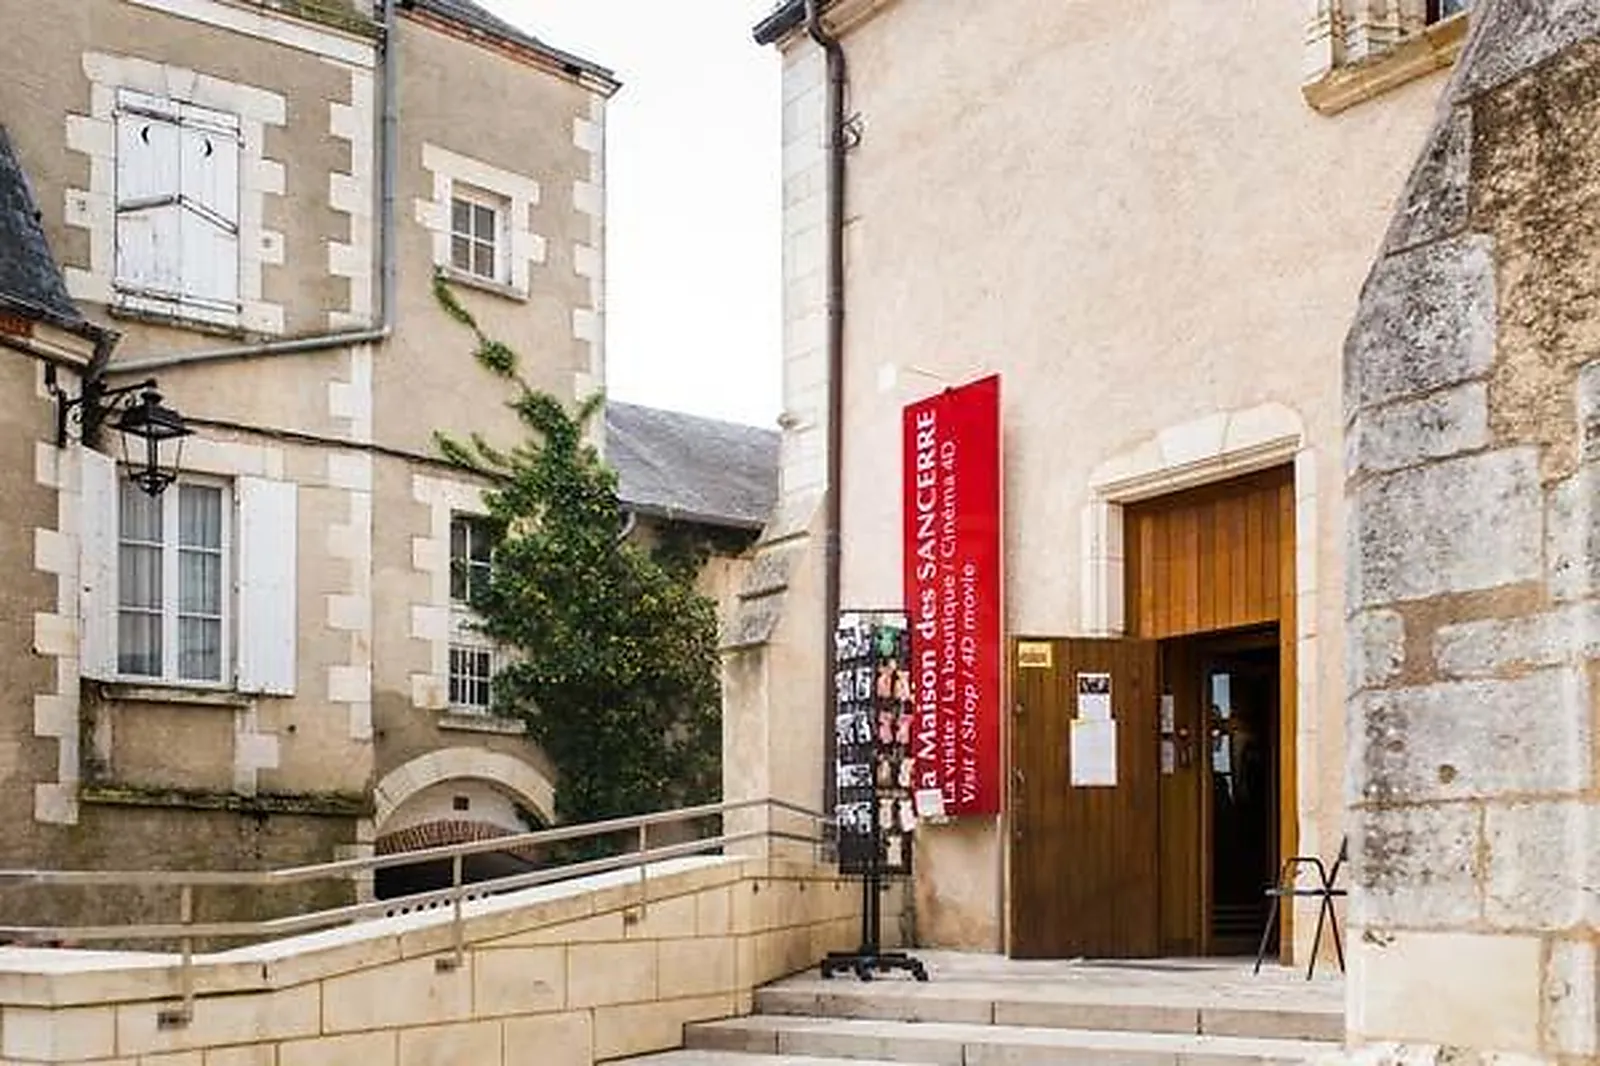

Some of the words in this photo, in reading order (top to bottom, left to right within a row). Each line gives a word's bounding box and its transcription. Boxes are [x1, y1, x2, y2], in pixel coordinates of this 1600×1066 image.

[941, 441, 956, 471] 4D
[916, 408, 937, 580] SANCERRE
[941, 474, 956, 557] Cinéma
[916, 589, 937, 640] des
[961, 562, 976, 630] movie
[941, 575, 959, 675] boutique
[960, 636, 976, 663] 4D
[917, 650, 937, 761] Maison
[942, 679, 956, 703] La
[962, 684, 979, 740] Shop
[941, 721, 956, 776] visite
[961, 758, 976, 804] Visit
